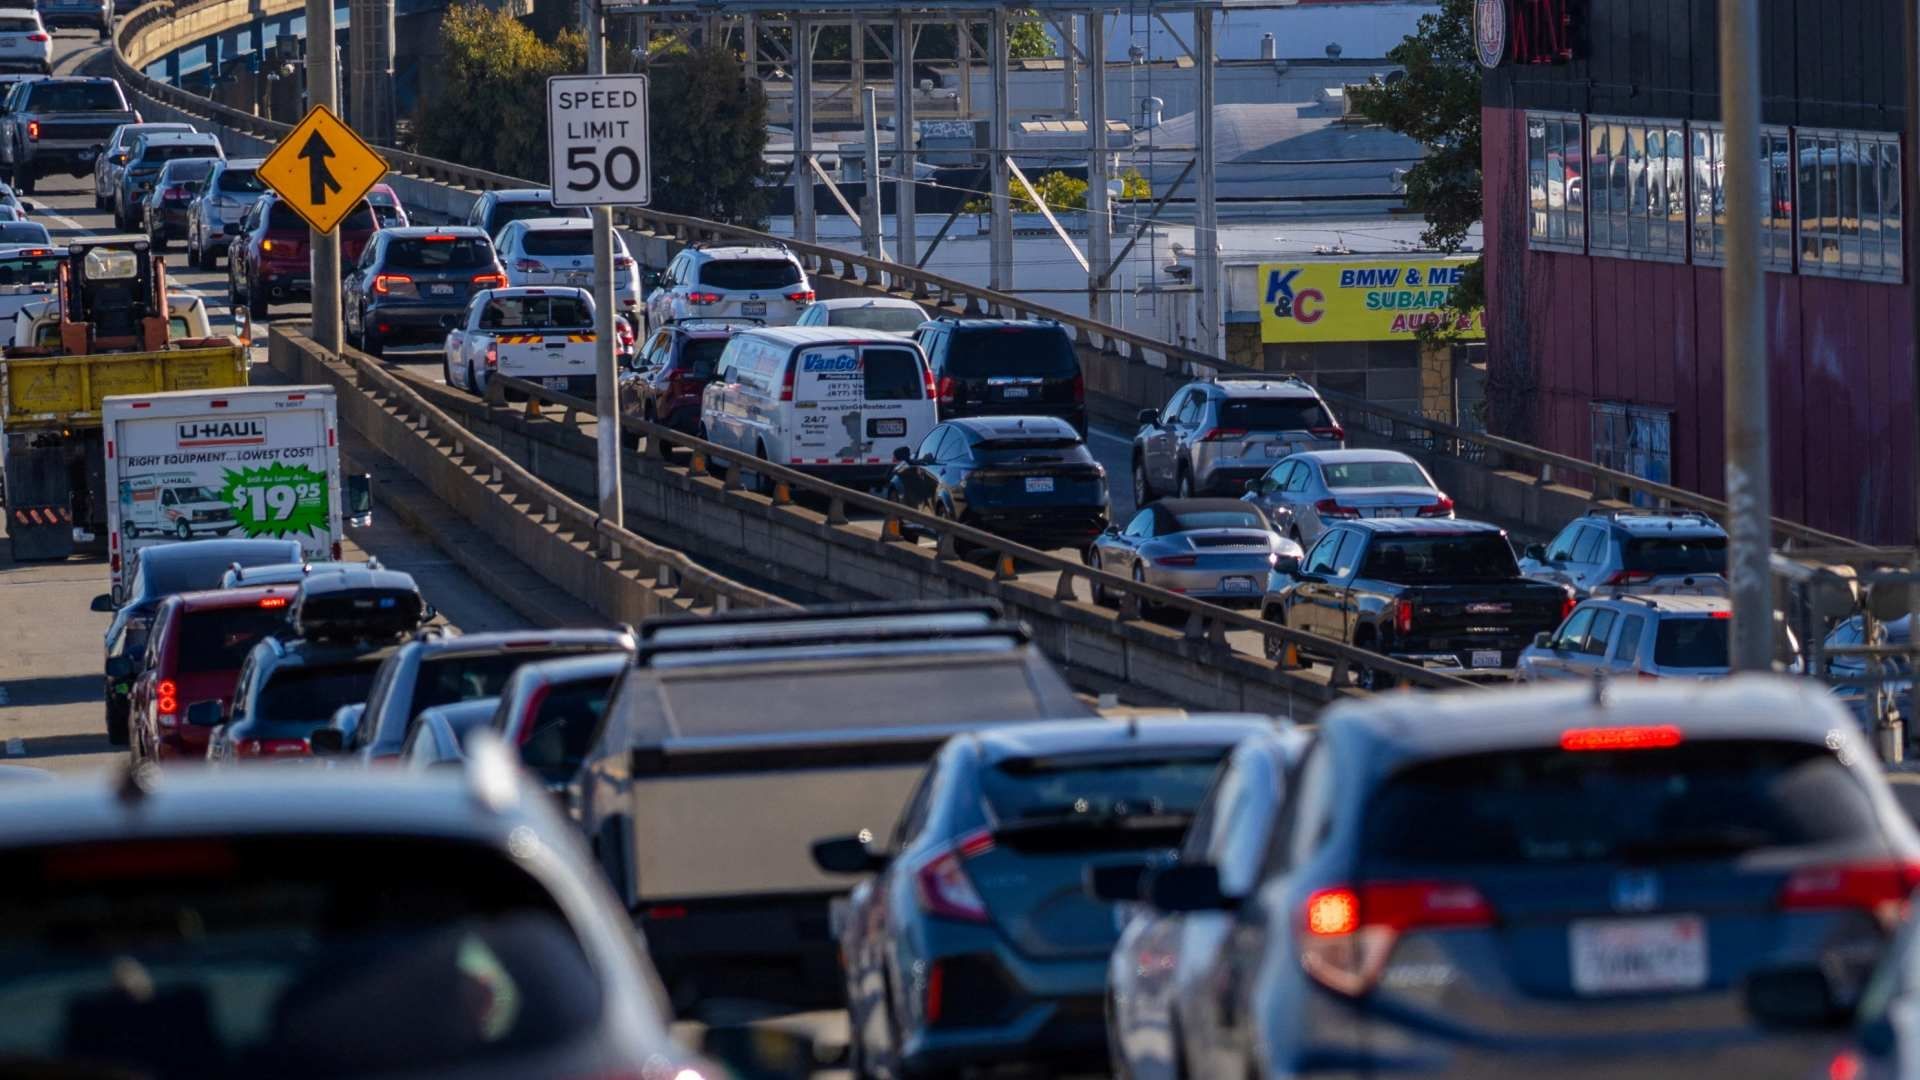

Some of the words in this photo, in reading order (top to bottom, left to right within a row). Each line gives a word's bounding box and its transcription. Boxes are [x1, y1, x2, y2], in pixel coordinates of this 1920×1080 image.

[559, 90, 637, 109] SPEED
[567, 120, 629, 139] LIMIT
[566, 146, 640, 192] 50
[1340, 268, 1401, 287] BMW
[1405, 268, 1422, 286] &
[1428, 267, 1465, 286] ME
[804, 415, 827, 423] 24/7
[180, 421, 263, 439] U-HAUL
[128, 456, 160, 467] RIGHT
[283, 447, 314, 459] COST!
